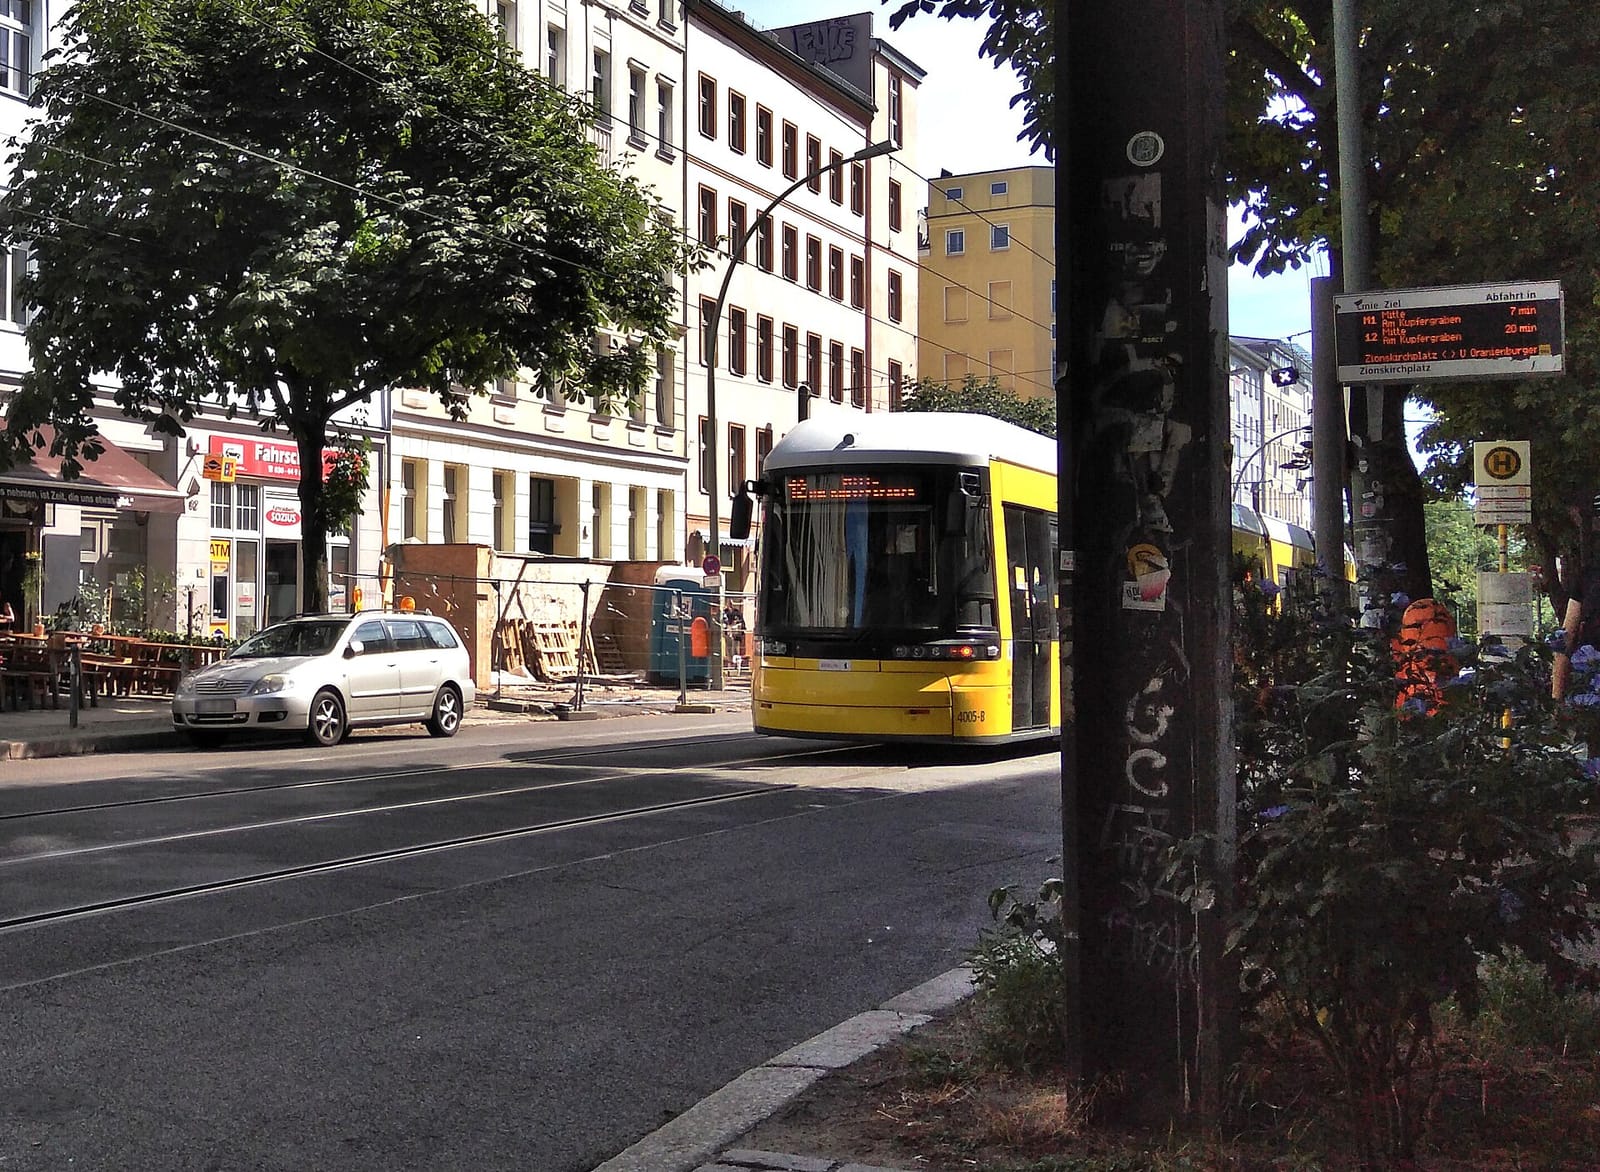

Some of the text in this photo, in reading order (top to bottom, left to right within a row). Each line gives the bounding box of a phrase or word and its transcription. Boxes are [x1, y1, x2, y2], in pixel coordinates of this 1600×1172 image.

[1486, 291, 1537, 301] Abfahrt in
[1384, 300, 1401, 309] Ziel
[1382, 311, 1406, 319] Mitte
[1509, 306, 1537, 316] 7 min
[1363, 315, 1377, 325] M1
[1382, 316, 1462, 328] Am Kupfergraben
[1382, 328, 1407, 337] Mitte
[1505, 323, 1537, 333] 20 min
[1364, 333, 1378, 342] 12
[1383, 333, 1462, 345] Am Kupfergraben
[1470, 346, 1538, 358] Oranienburger
[1360, 364, 1431, 375] Zionskirchplatz
[1493, 454, 1512, 474] H
[210, 543, 230, 557] ATM
[957, 711, 986, 723] 4005-B
